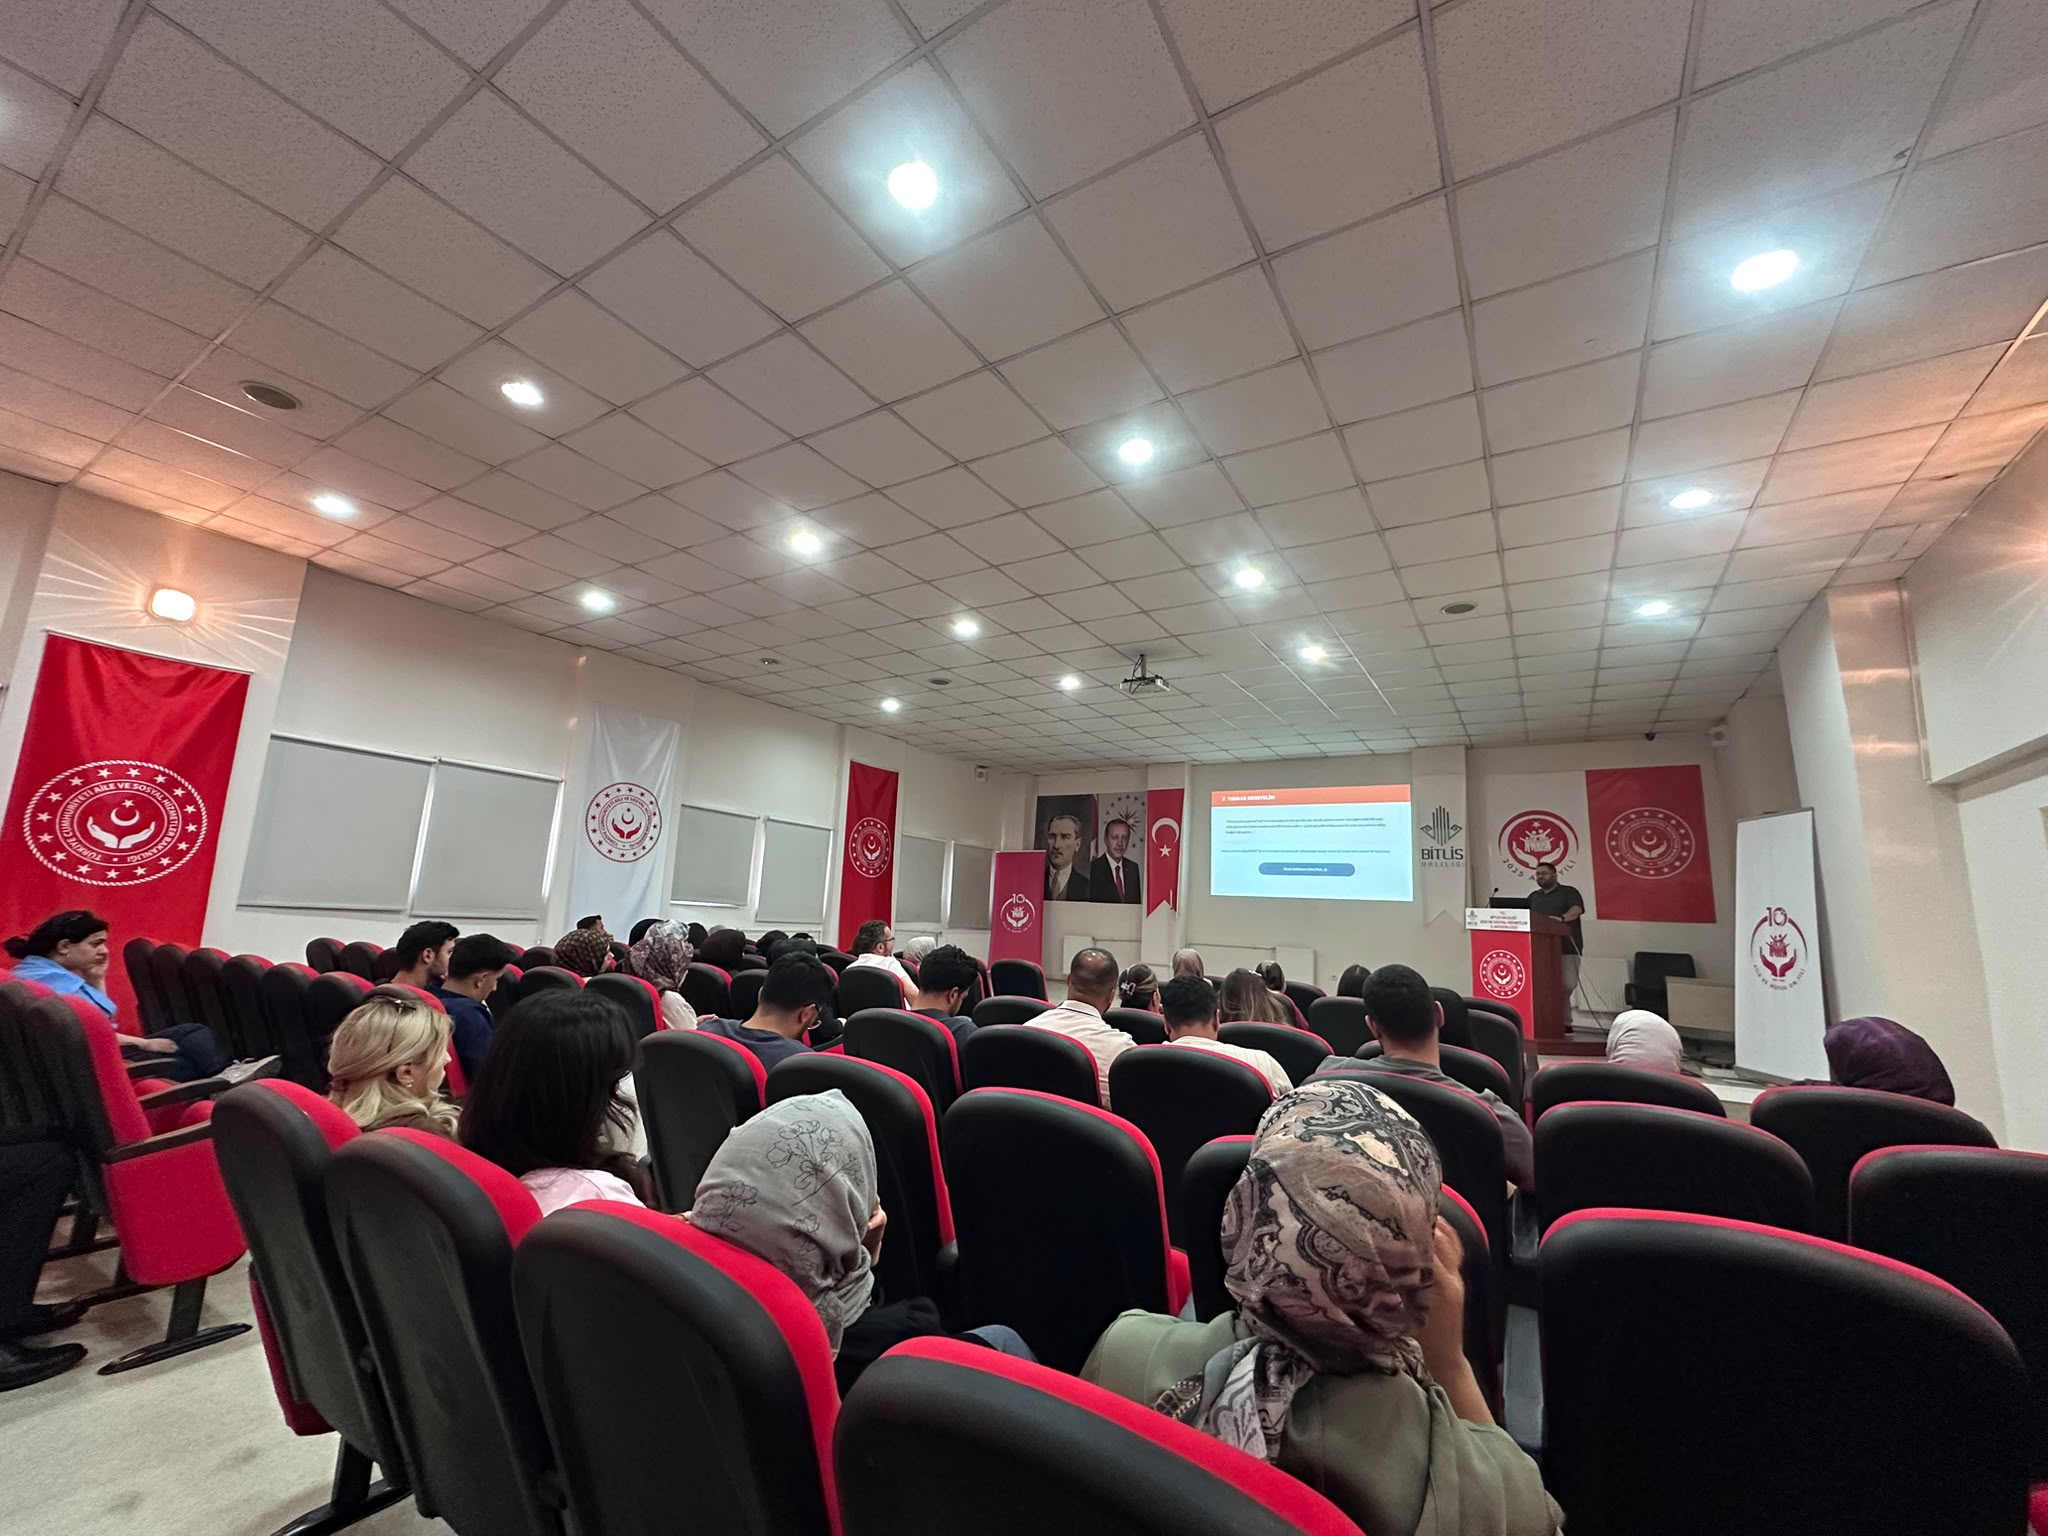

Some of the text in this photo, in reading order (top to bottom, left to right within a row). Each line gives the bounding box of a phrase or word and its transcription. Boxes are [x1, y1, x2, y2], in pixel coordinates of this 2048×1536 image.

[116, 782, 131, 790] VE
[130, 782, 163, 801] SOSYAL
[1421, 845, 1464, 860] BİTLİS
[1502, 858, 1577, 877] 2025 YILI
[1766, 907, 1788, 927] 10
